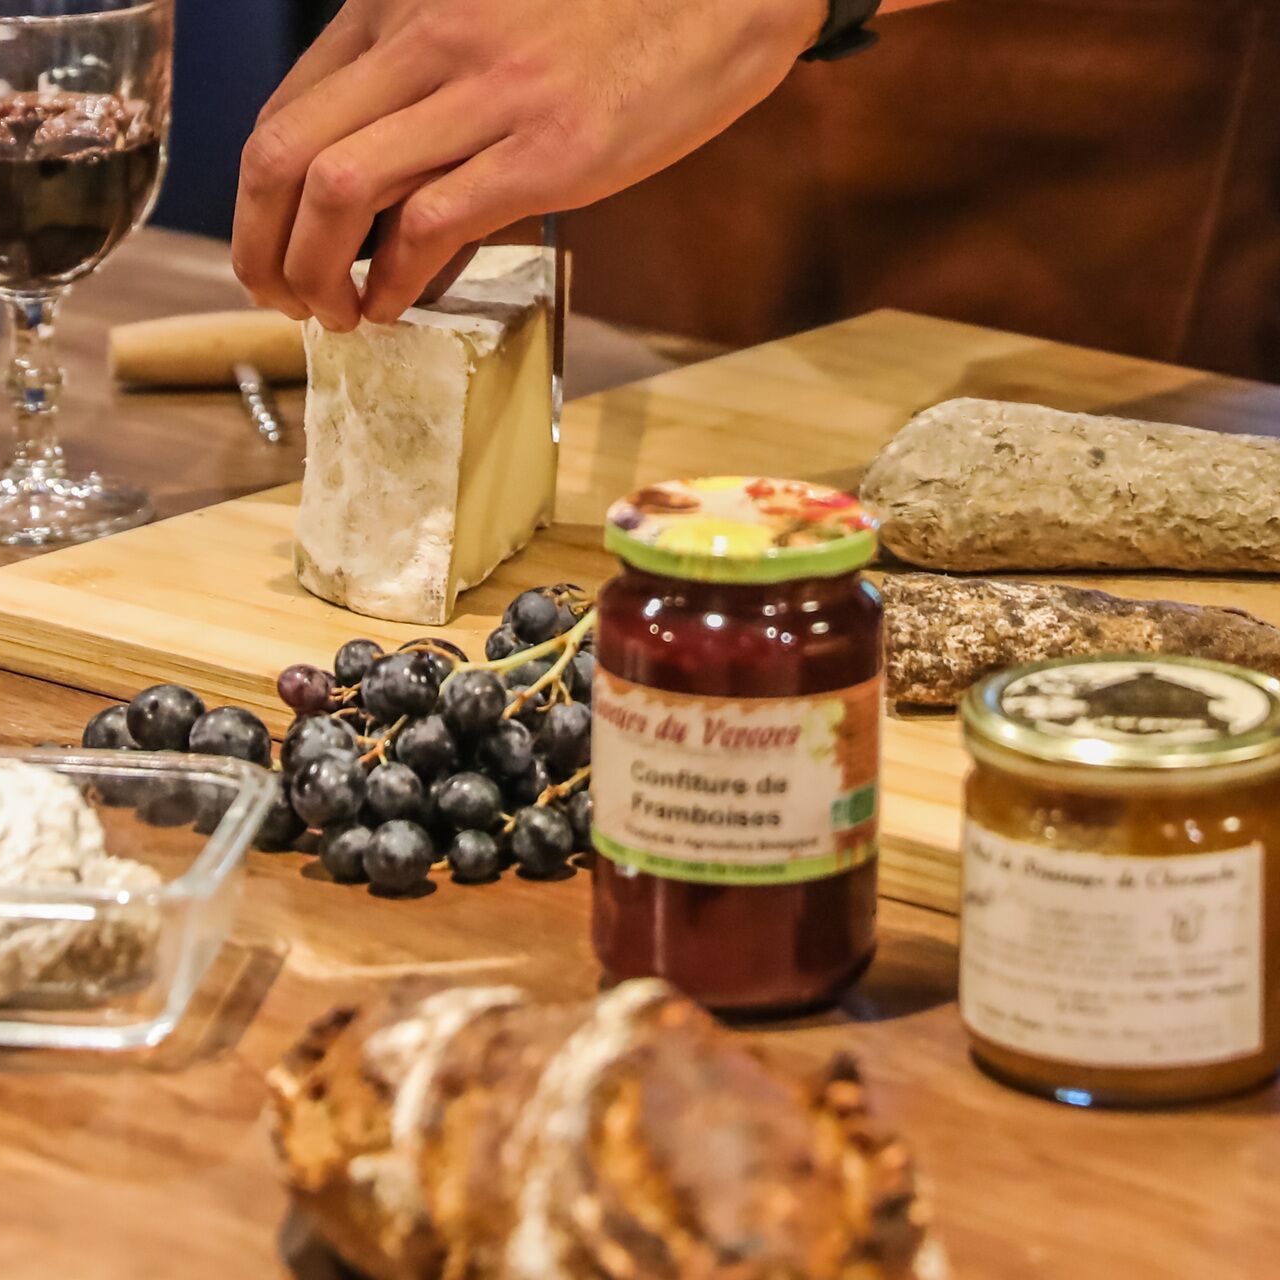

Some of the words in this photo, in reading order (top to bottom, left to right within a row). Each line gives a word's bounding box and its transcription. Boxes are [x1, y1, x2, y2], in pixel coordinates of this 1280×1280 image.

[654, 714, 689, 745] du
[629, 760, 749, 797] Confiture
[755, 774, 789, 796] de
[630, 792, 782, 828] Framboises
